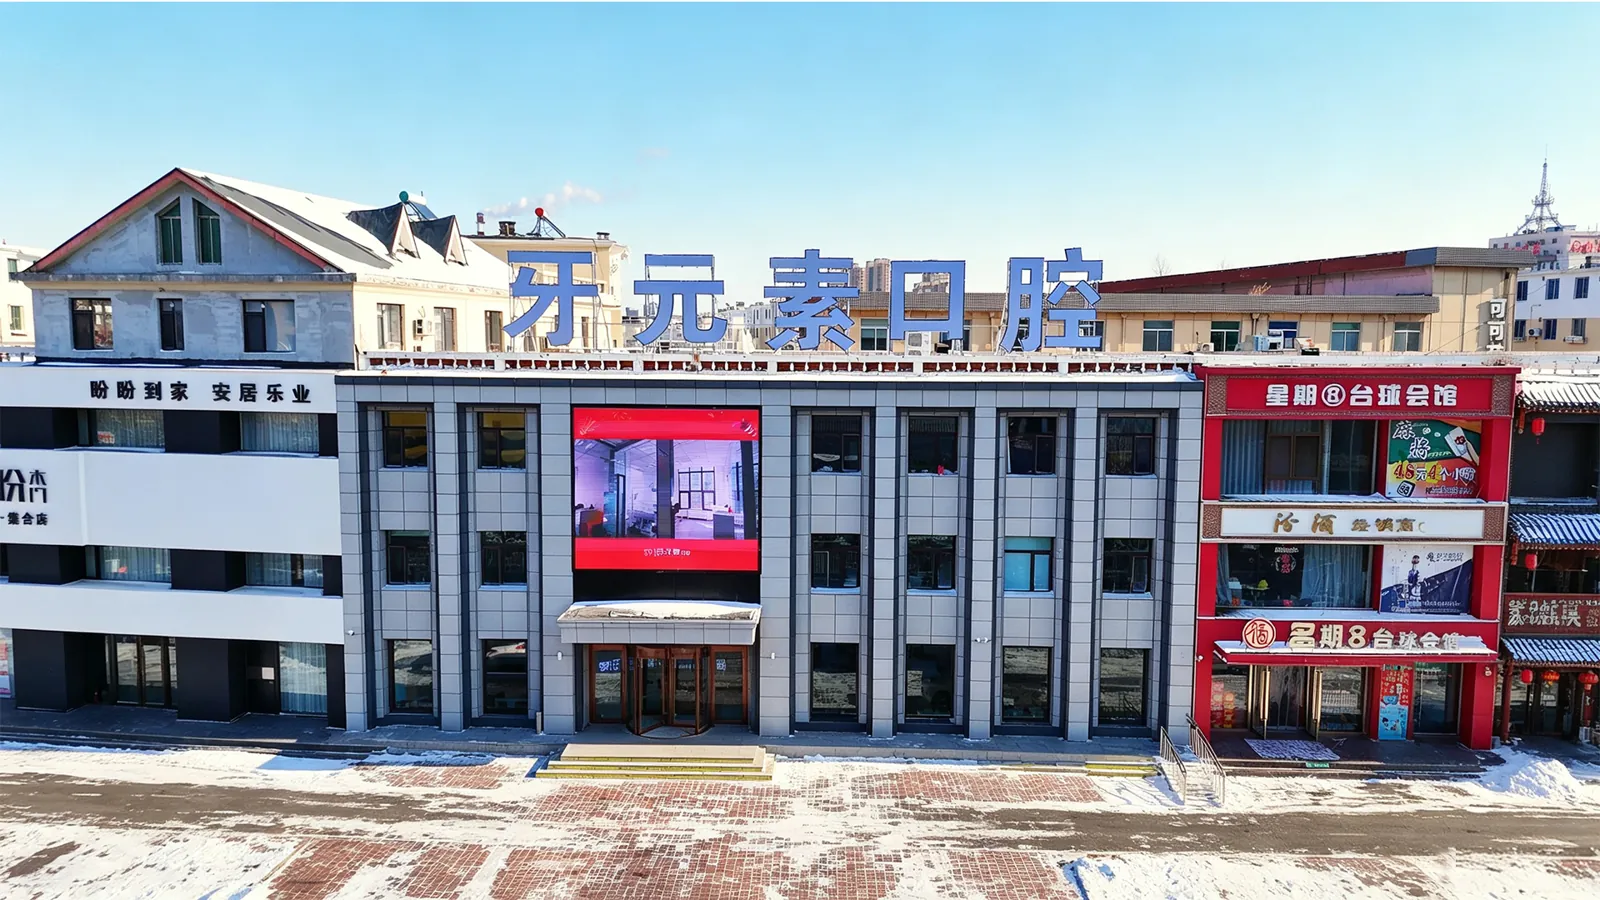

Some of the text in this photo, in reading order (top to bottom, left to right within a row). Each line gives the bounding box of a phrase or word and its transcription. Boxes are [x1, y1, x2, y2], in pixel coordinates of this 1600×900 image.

[503, 247, 1104, 353] 牙元素口腔
[1485, 298, 1508, 351] 可可
[89, 380, 312, 403] 盼盼到家 安居乐业
